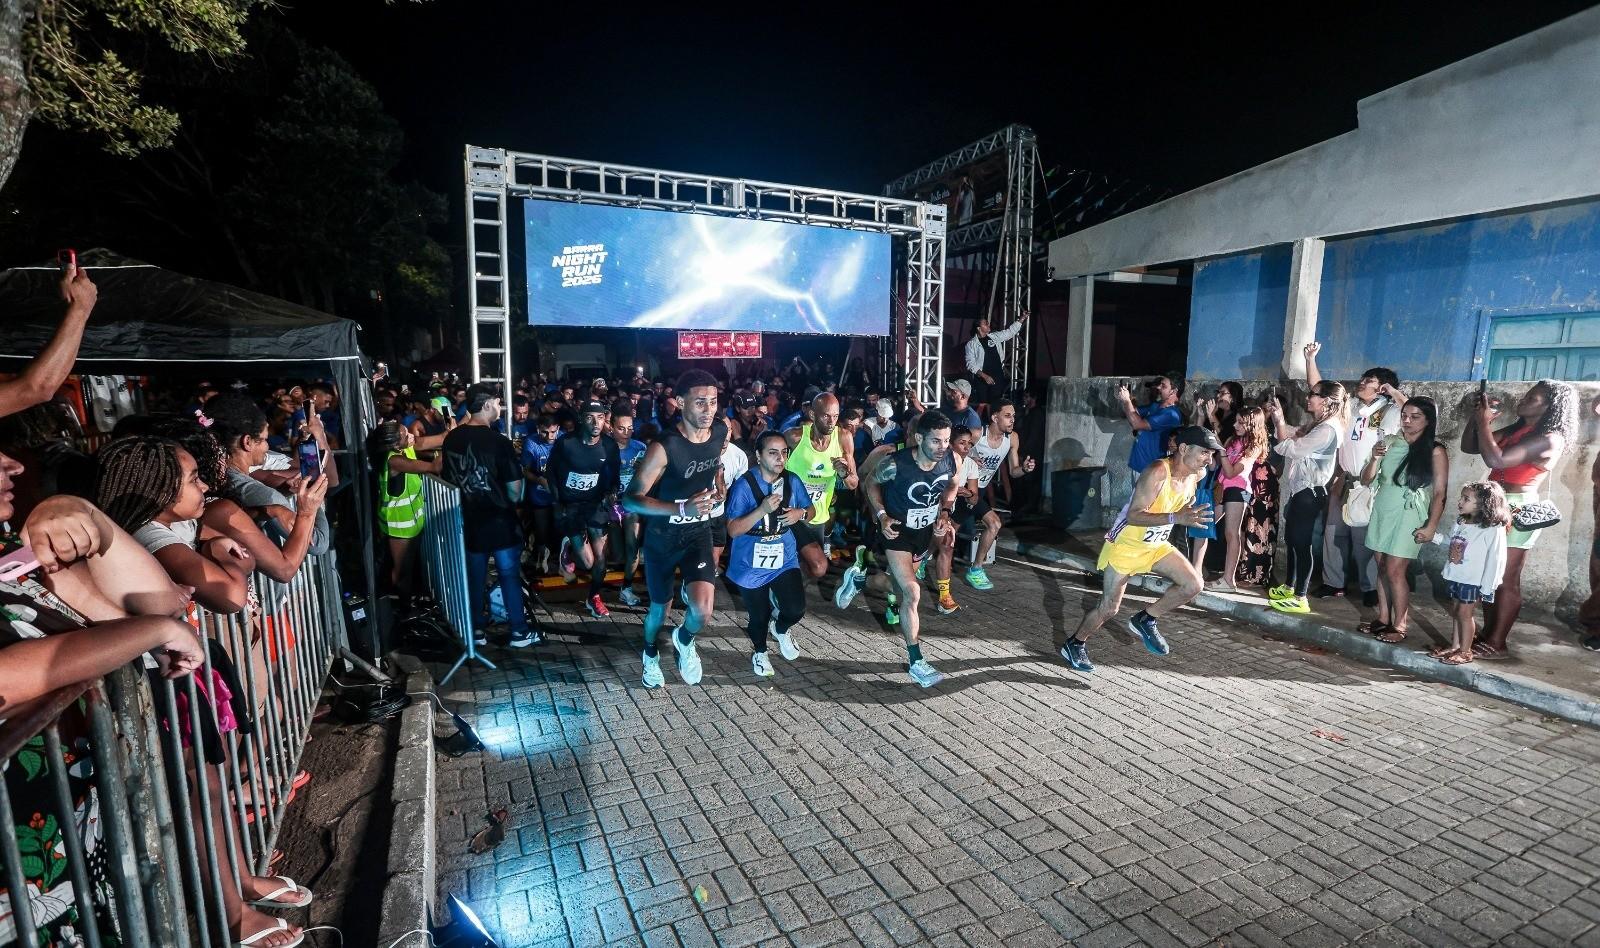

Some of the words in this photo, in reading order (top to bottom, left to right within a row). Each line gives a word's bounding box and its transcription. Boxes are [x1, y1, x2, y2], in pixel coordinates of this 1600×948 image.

[552, 252, 608, 267] NIGHT
[562, 264, 601, 277] RUN
[570, 479, 593, 489] 334
[915, 515, 928, 528] 15
[1143, 530, 1169, 542] 275
[759, 555, 778, 567] 77
